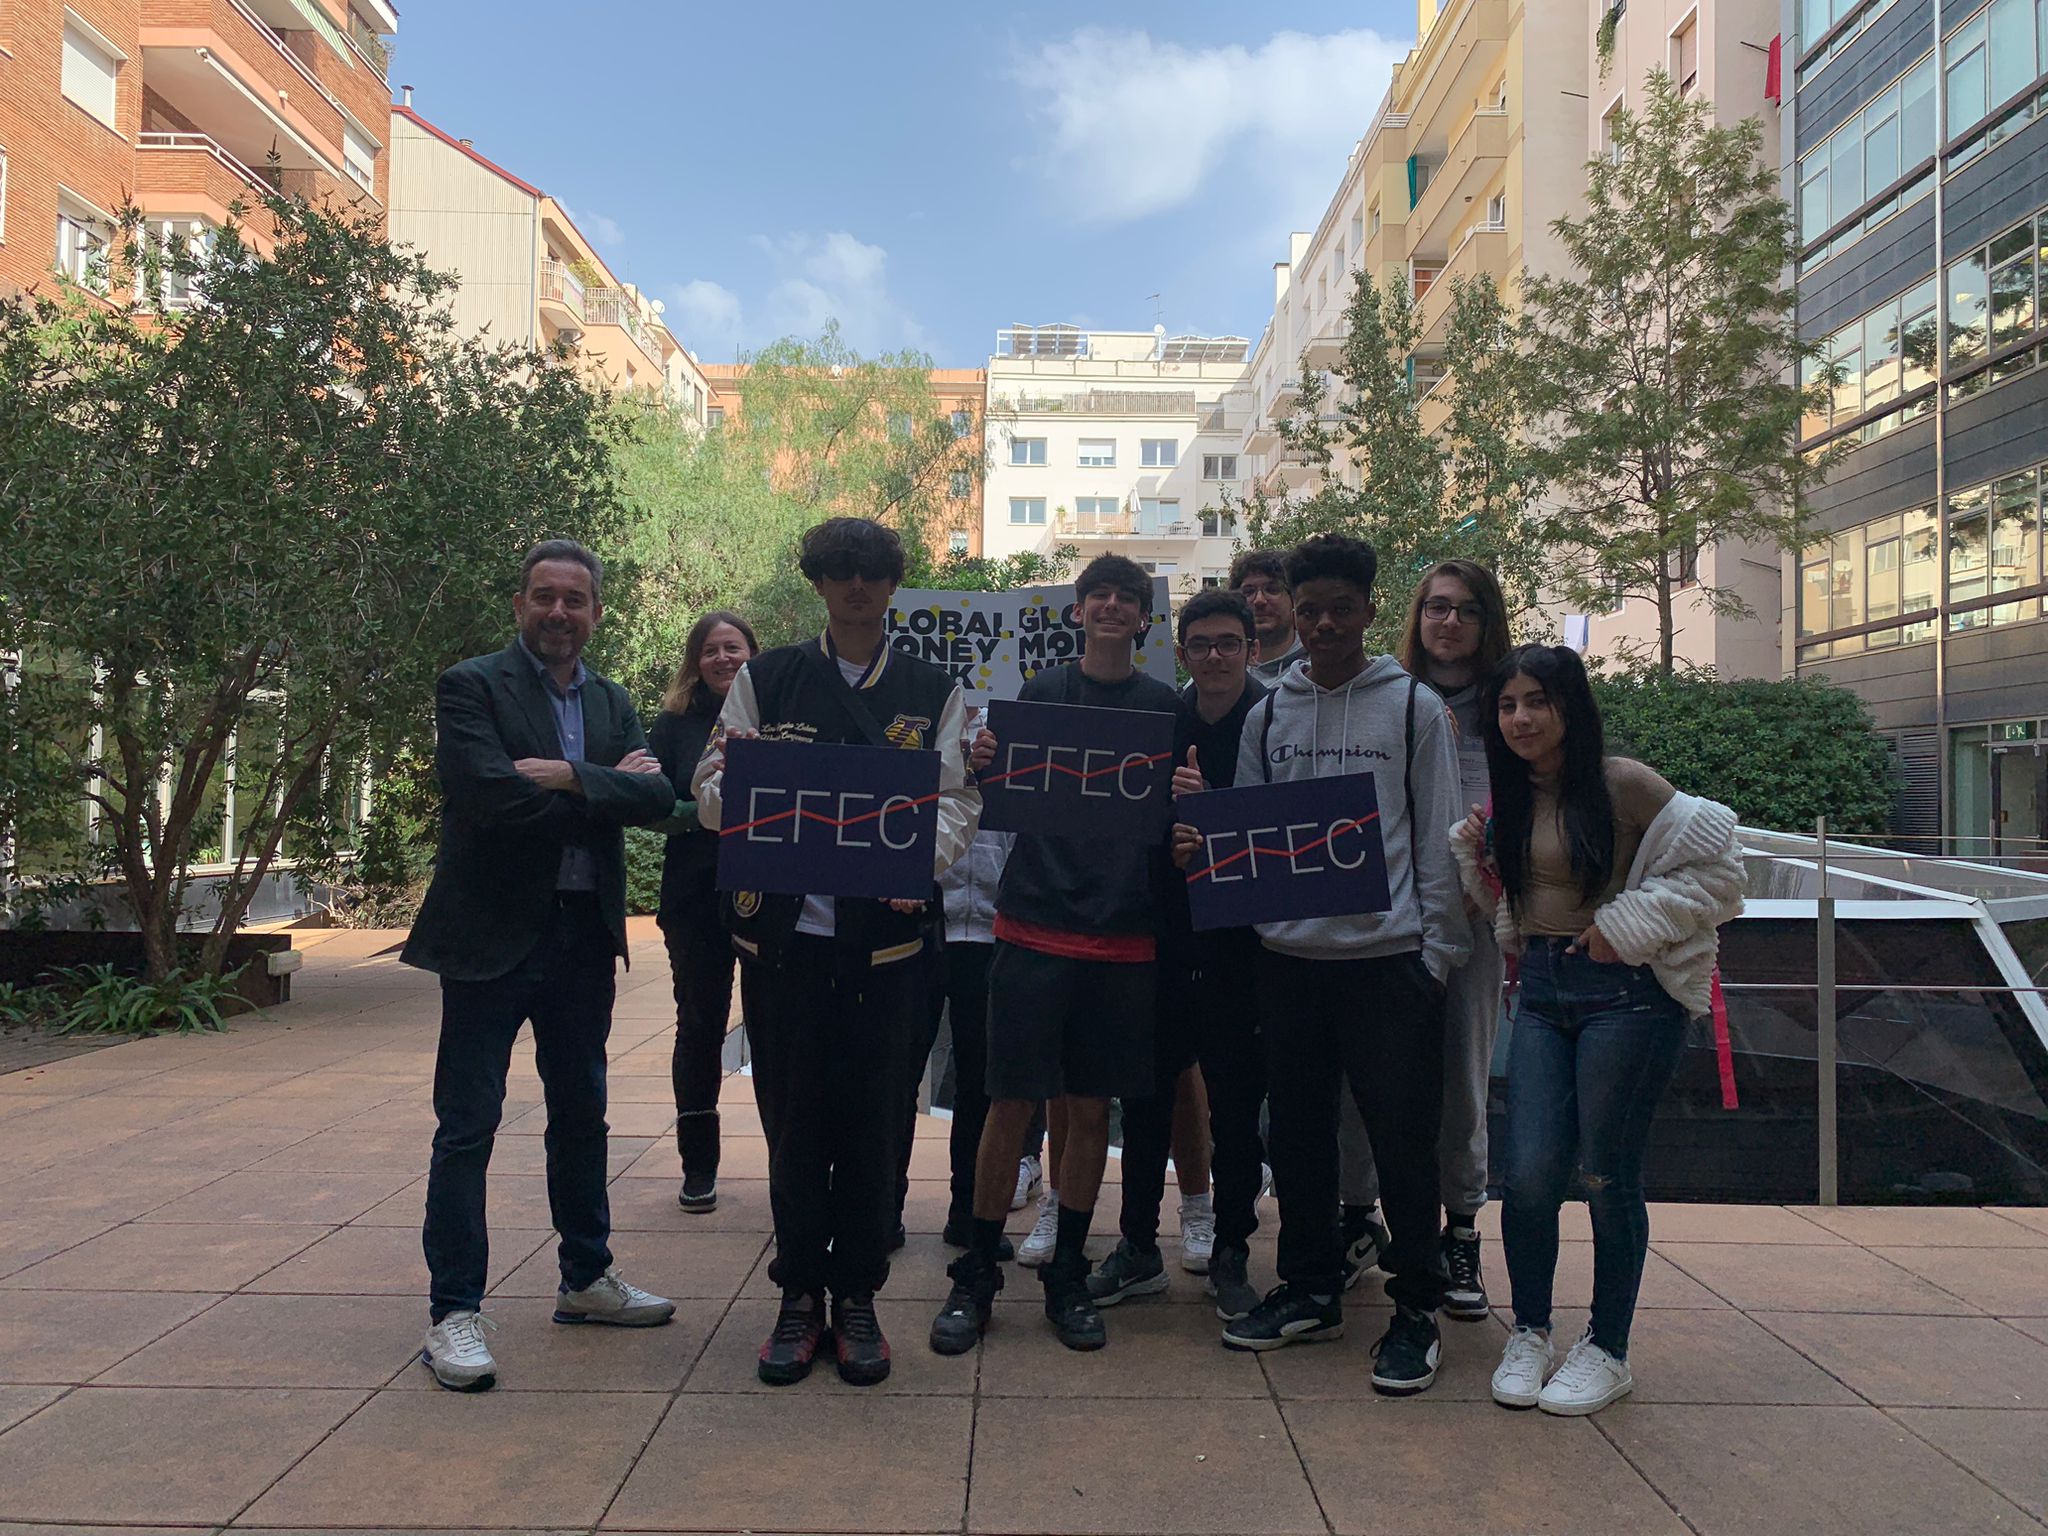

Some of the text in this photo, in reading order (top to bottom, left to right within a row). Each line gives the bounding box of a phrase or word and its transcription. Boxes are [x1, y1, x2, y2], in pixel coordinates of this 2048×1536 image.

[883, 608, 1014, 638] LOBAL
[886, 635, 1001, 663] ONEY
[1018, 624, 1153, 660] MOY
[1005, 742, 1154, 800] EFEC
[1270, 744, 1393, 764] Champion
[747, 787, 919, 849] EFEC
[1206, 818, 1366, 883] EFEC
